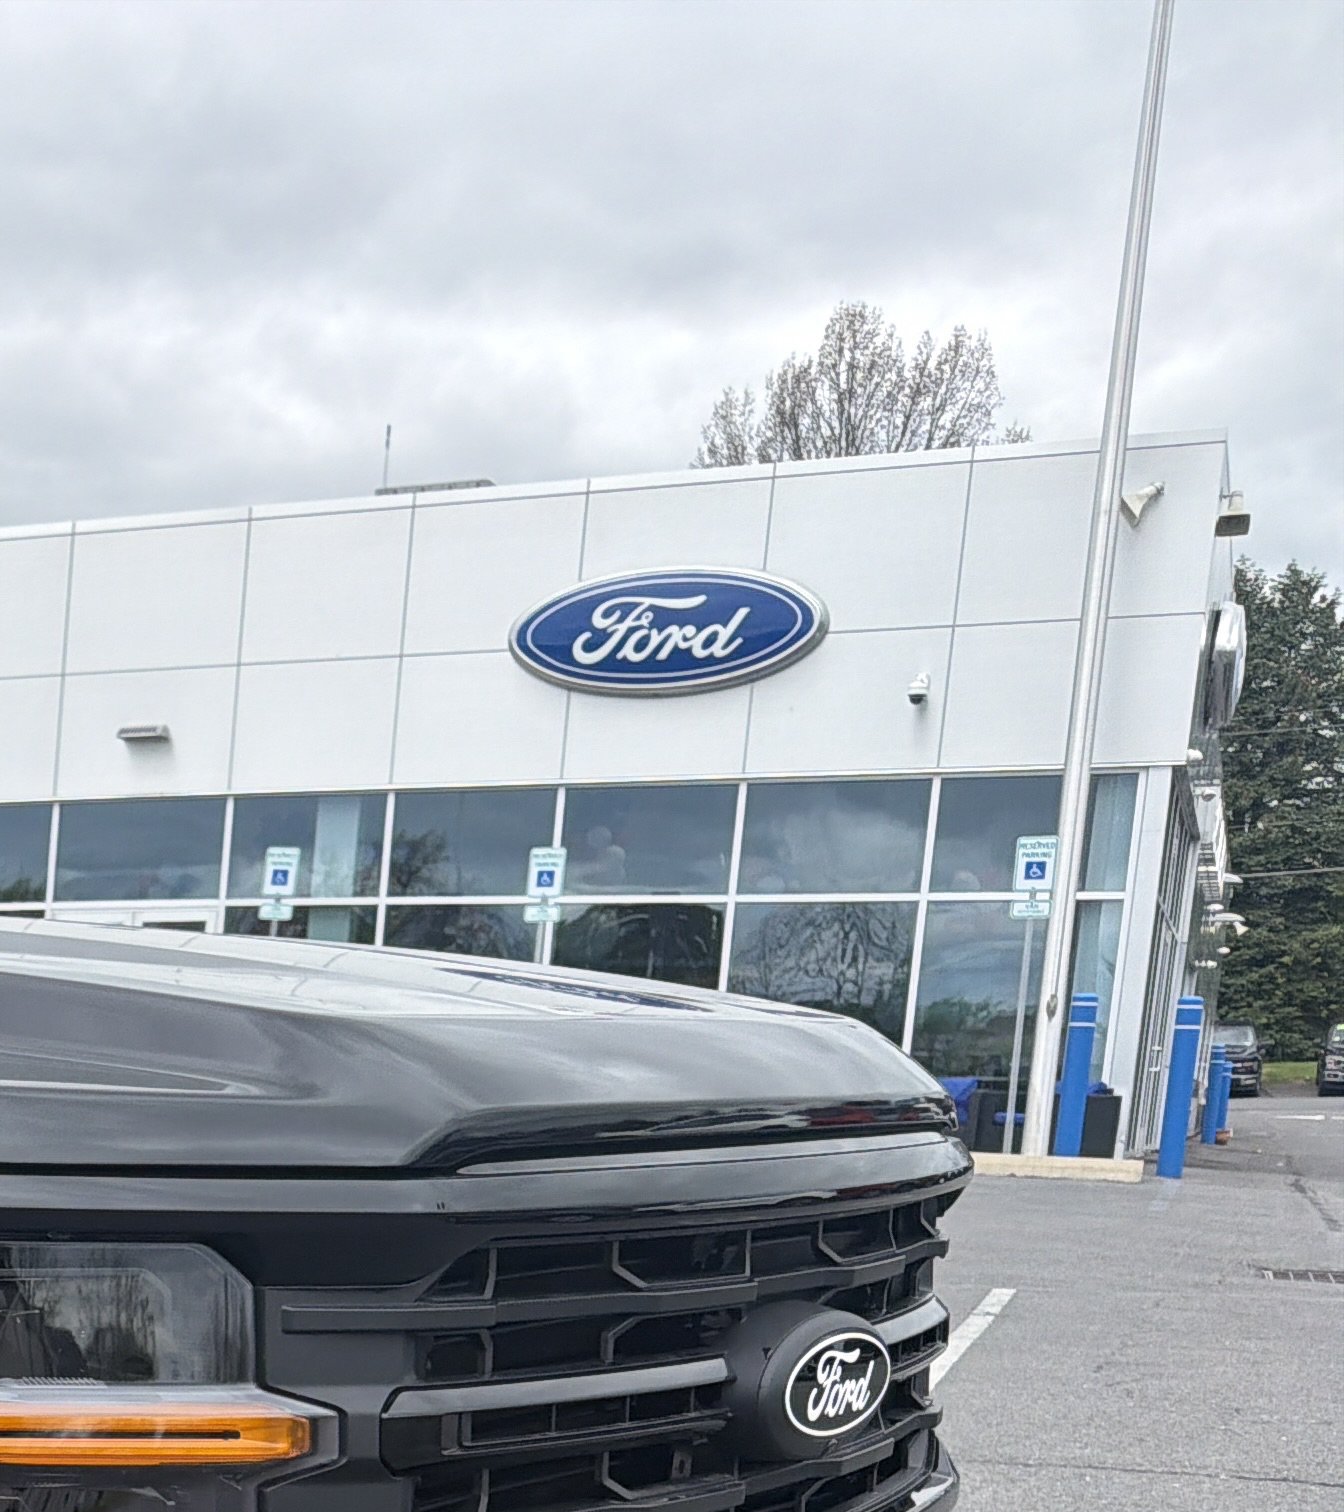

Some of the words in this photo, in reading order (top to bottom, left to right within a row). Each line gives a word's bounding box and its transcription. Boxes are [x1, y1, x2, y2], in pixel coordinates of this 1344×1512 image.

[572, 595, 751, 665] Ford
[1021, 851, 1053, 859] PARKING
[807, 1348, 875, 1422] Ford
